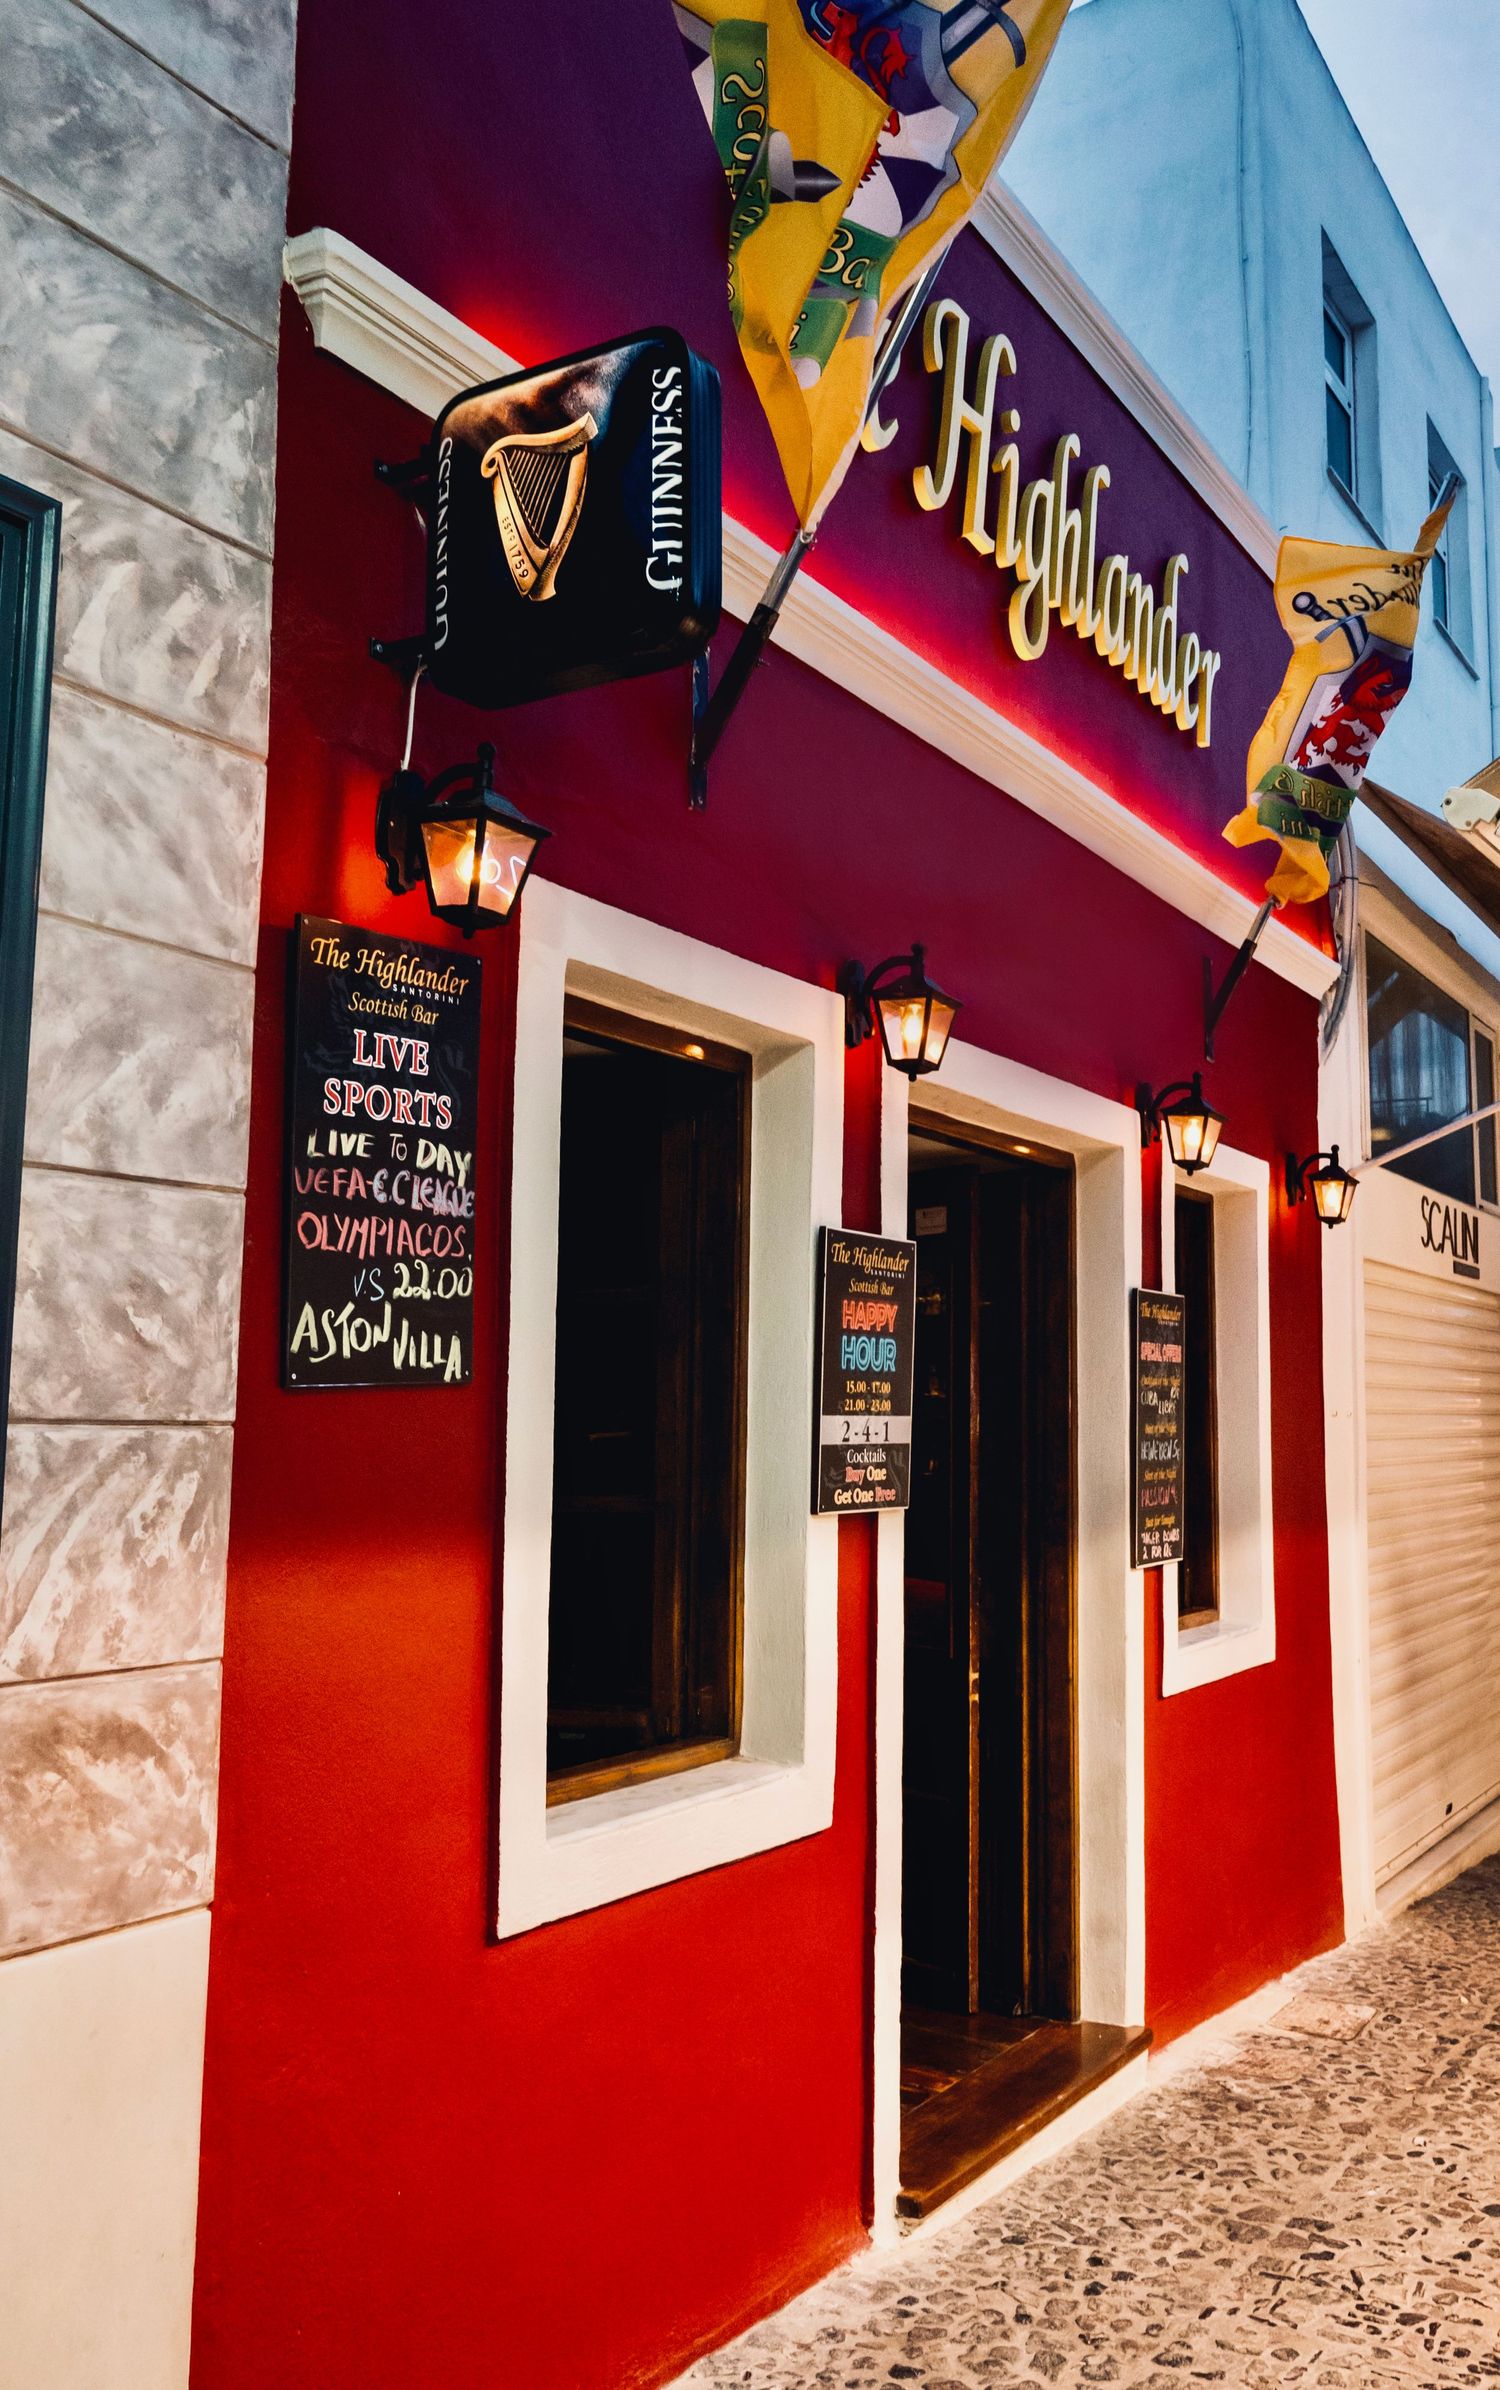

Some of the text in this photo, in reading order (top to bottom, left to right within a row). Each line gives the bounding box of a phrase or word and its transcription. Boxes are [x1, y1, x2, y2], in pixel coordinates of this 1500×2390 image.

[645, 366, 683, 601] GUINNESS
[913, 298, 1221, 748] Highlander
[509, 544, 529, 578] 1759
[310, 937, 470, 995] The Highlander
[348, 991, 439, 1025] Scottish Bar
[393, 983, 460, 1005] SANTORINI
[352, 1028, 429, 1076] LIVE
[323, 1077, 452, 1129] SPORTS
[307, 1129, 376, 1158] LIVE
[416, 1138, 472, 1187] DAY
[297, 1211, 466, 1260] OLYMPIACOS
[831, 1242, 909, 1273] The Highlander
[849, 1278, 894, 1296] Scottish Bar
[842, 1299, 898, 1332] HAPPY
[290, 1301, 462, 1382] ASTON VILLA
[841, 1335, 897, 1372] HOUR
[846, 1380, 866, 1393] 15.00
[844, 1398, 865, 1411] 21.00
[847, 1448, 886, 1463] Cocktails
[845, 1466, 887, 1485] Buy One
[834, 1486, 896, 1505] Get One Free
